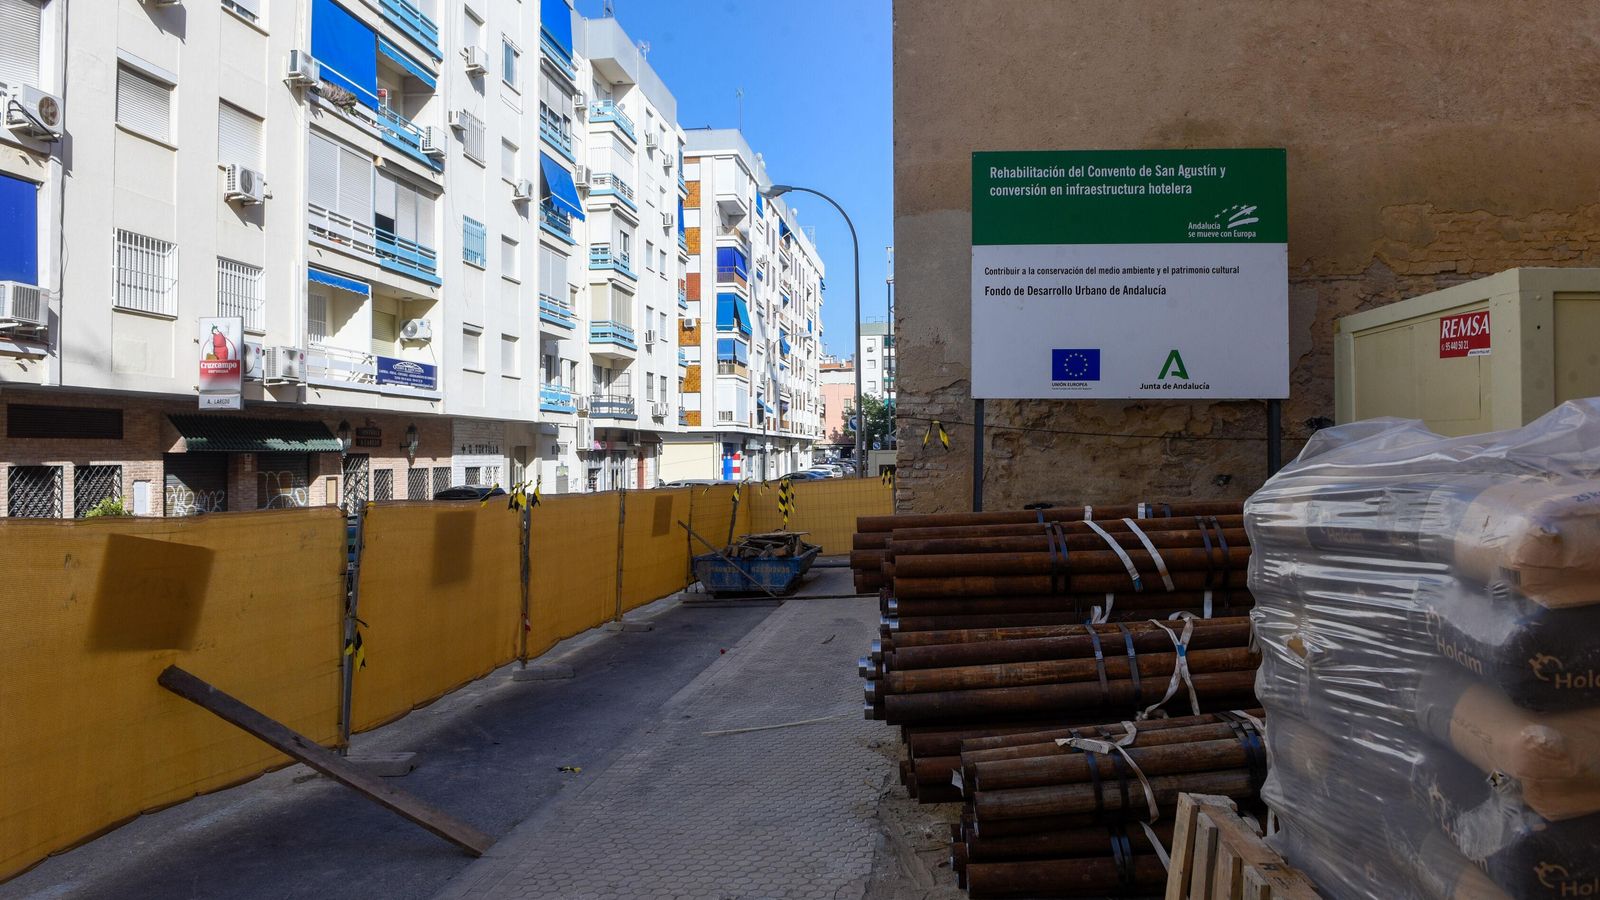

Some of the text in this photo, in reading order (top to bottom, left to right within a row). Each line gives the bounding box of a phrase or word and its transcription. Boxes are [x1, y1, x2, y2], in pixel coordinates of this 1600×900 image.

[989, 163, 1227, 179] Rehabilitación del Convento de San Agustín y
[989, 182, 1193, 197] conversión en infraestructura hotelera
[1187, 221, 1222, 231] Andalucía
[1187, 229, 1258, 240] se mueve con Europa
[984, 266, 1021, 276] Contribuir
[1028, 266, 1036, 275] la
[1036, 266, 1084, 275] conservación
[1085, 266, 1097, 275] del
[1098, 266, 1121, 275] medio
[1121, 265, 1156, 275] ambiente
[1156, 267, 1162, 277] y
[1162, 266, 1170, 275] el
[1171, 266, 1211, 276] patrimonio
[1211, 265, 1241, 275] cultural
[984, 283, 1167, 297] Fondo de Desarrollo Urbano de Andalucía
[1441, 314, 1490, 339] REMSA
[200, 361, 238, 371] Cruzcampo
[1139, 381, 1210, 390] Junta de Andalucía
[1435, 634, 1484, 675] Holcim
